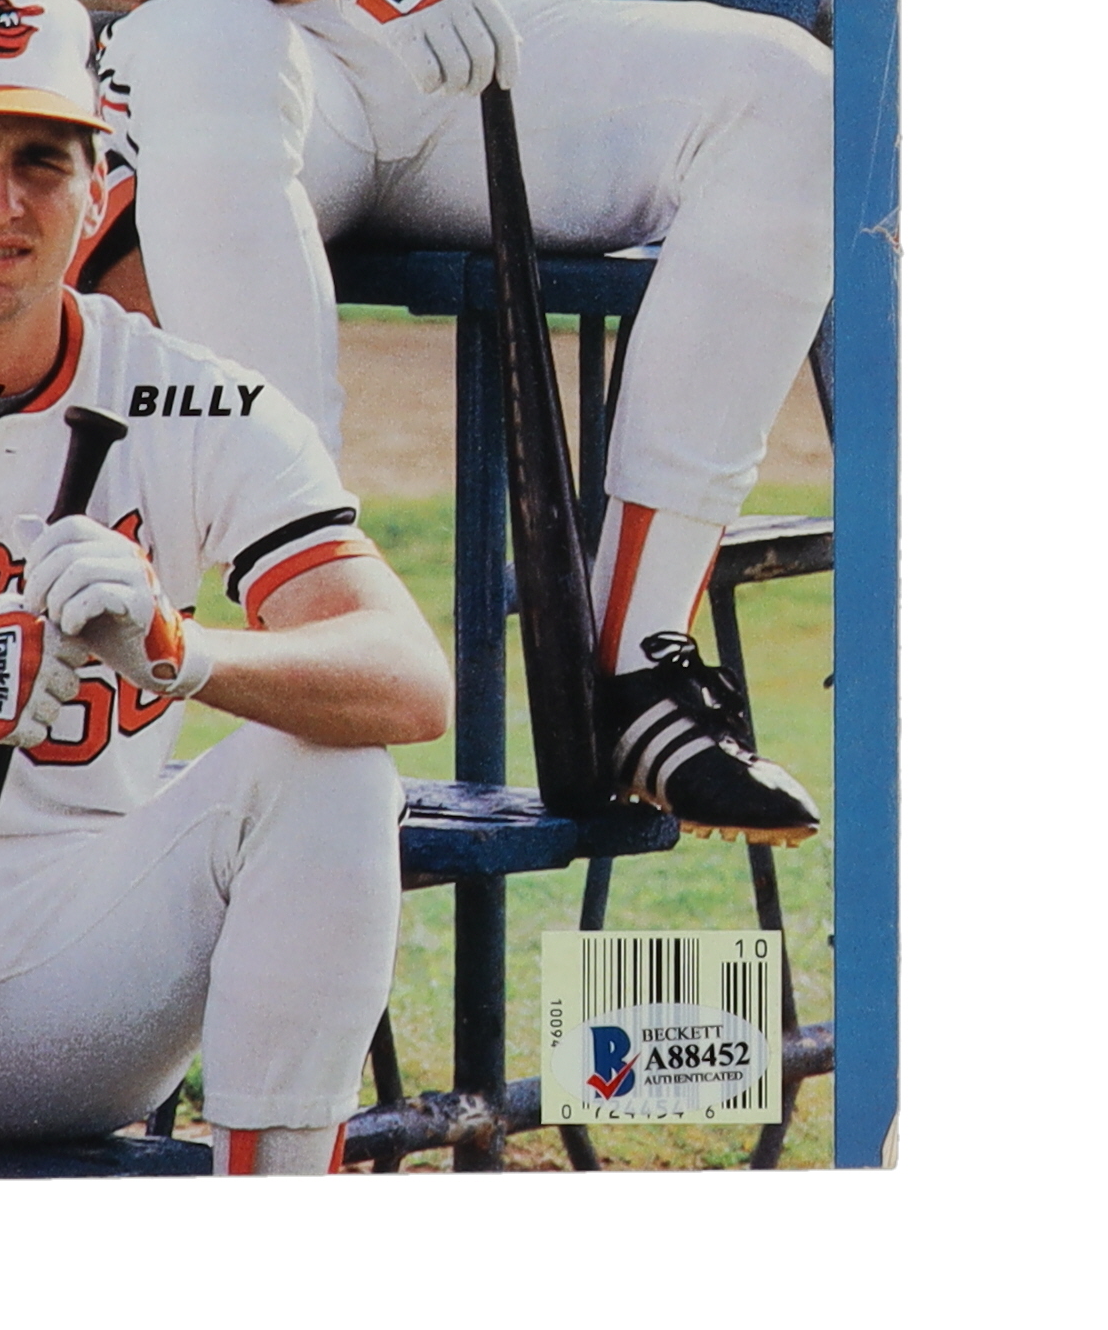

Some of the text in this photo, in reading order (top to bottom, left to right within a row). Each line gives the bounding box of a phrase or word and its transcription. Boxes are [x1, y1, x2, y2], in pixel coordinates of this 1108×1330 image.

[127, 384, 265, 418] BILLY
[734, 938, 769, 960] 10
[549, 999, 564, 1048] 10094
[642, 1024, 724, 1043] BECKETT
[644, 1041, 751, 1072] A88452
[644, 1070, 744, 1086] AUTHENTICATED
